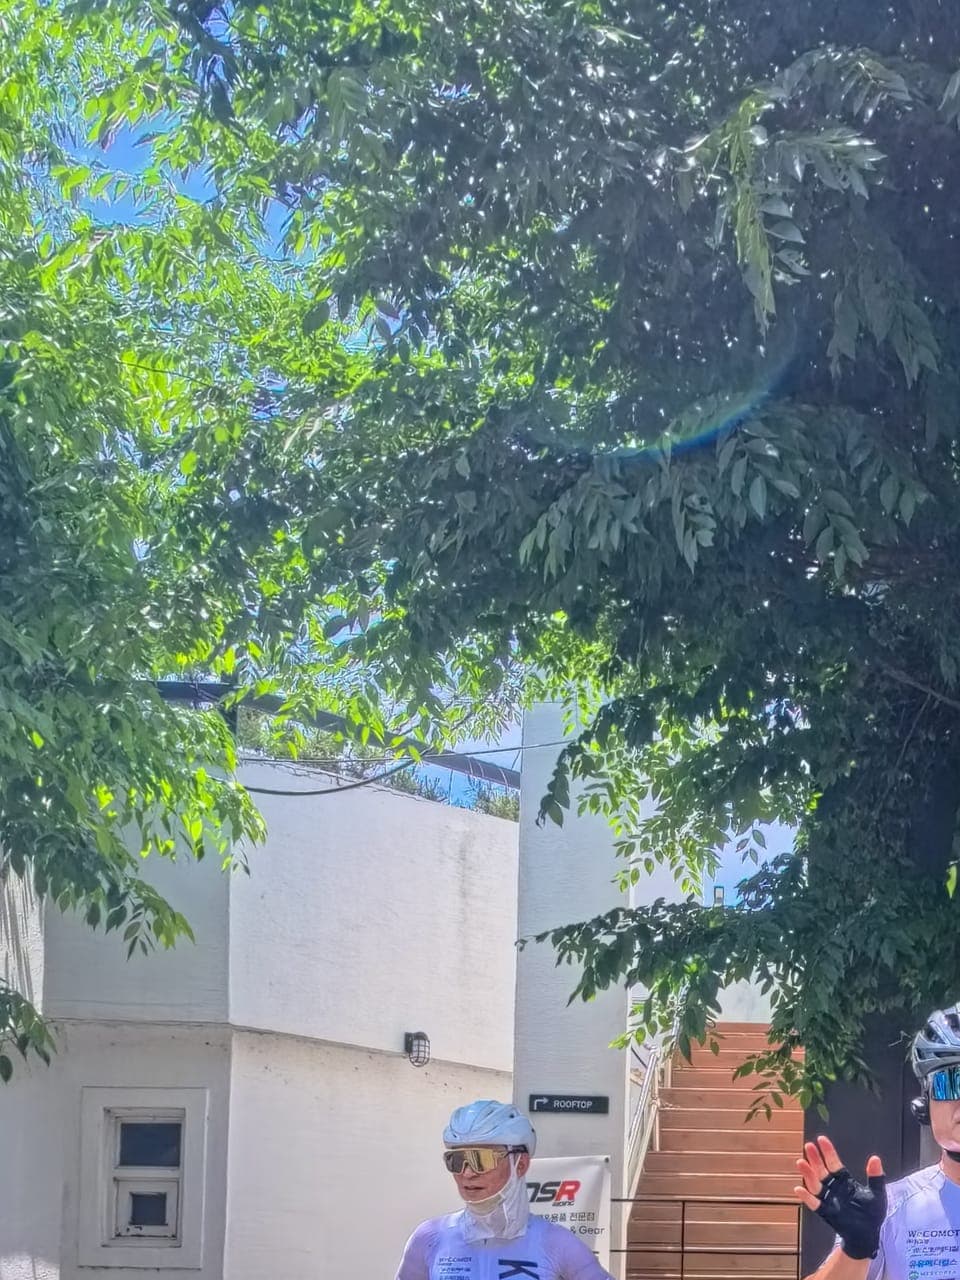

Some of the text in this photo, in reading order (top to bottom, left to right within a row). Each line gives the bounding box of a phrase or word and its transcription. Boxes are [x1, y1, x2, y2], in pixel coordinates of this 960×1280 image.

[553, 1100, 593, 1109] ROOFTOP
[569, 1212, 596, 1222] 전문점
[579, 1225, 606, 1236] Gear
